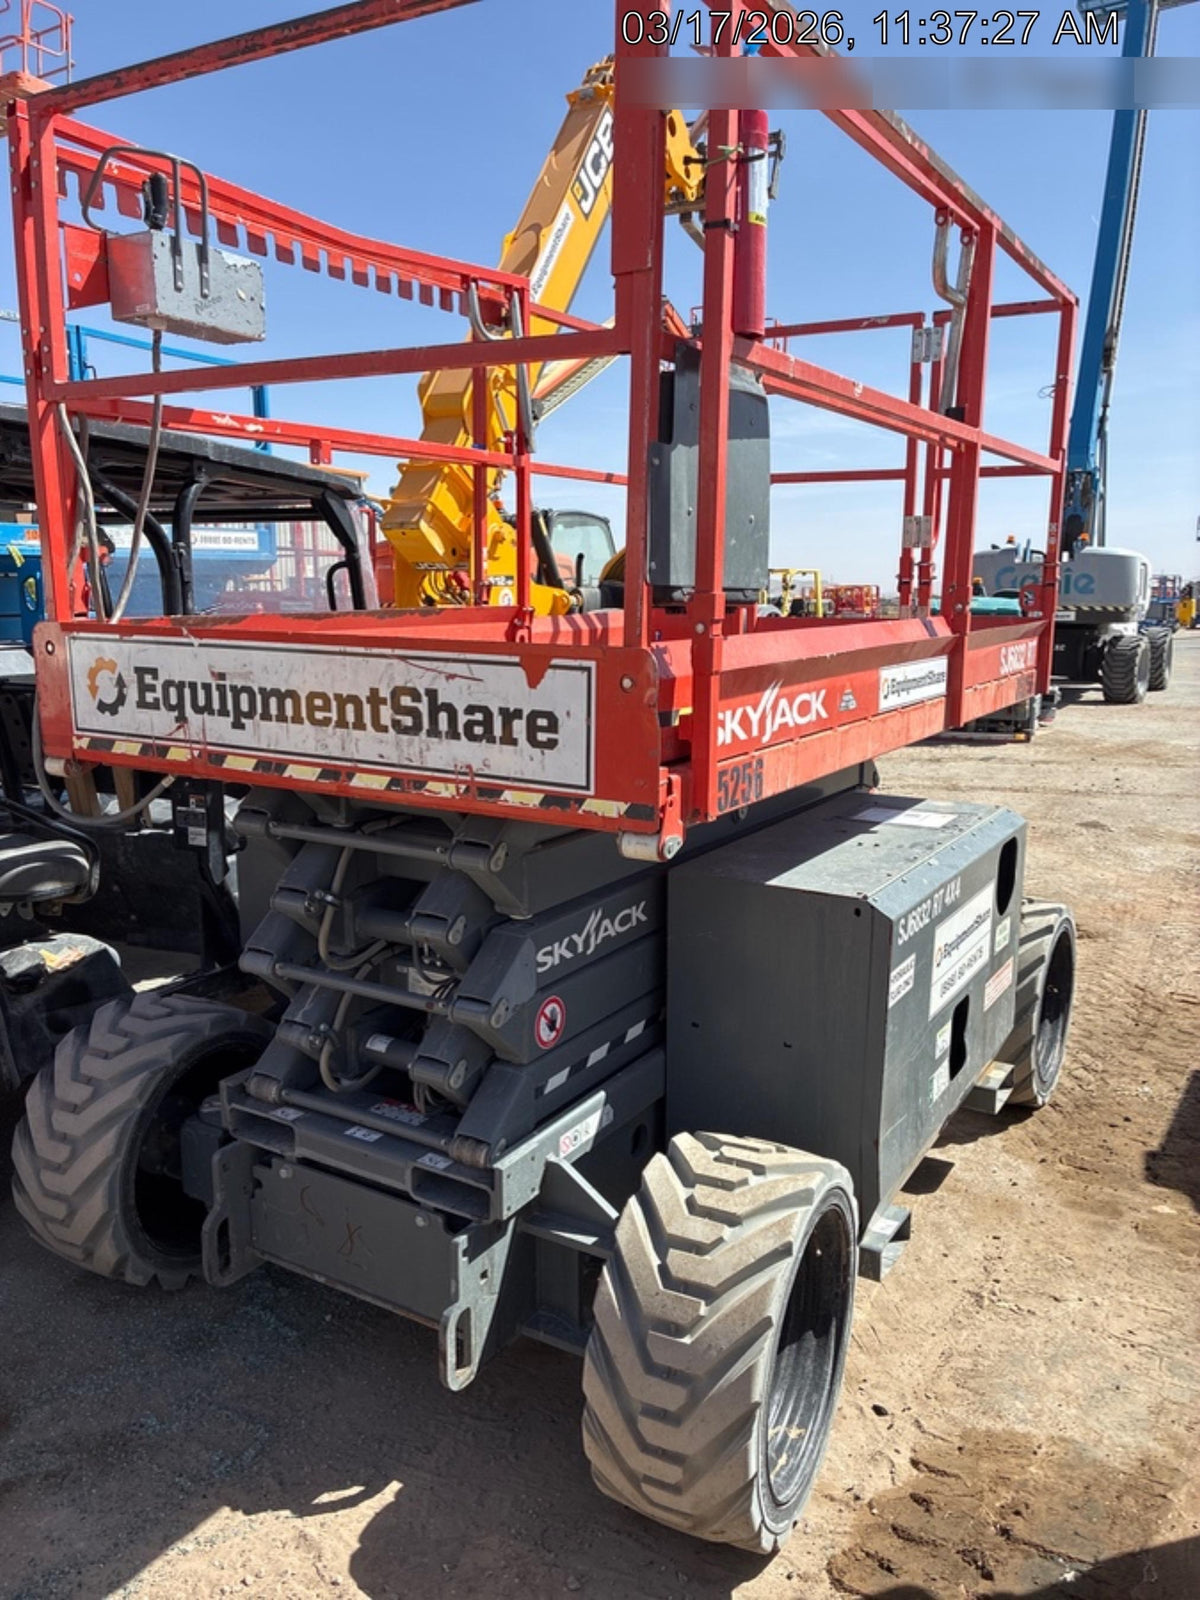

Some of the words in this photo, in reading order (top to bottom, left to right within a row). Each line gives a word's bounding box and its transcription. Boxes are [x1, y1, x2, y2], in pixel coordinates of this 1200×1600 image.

[133, 665, 560, 751] EquipmentShare
[890, 670, 946, 697] EquipmentShare
[717, 757, 764, 811] 5256
[536, 900, 648, 973] SKYJACK
[943, 907, 992, 959] EquipmentShare
